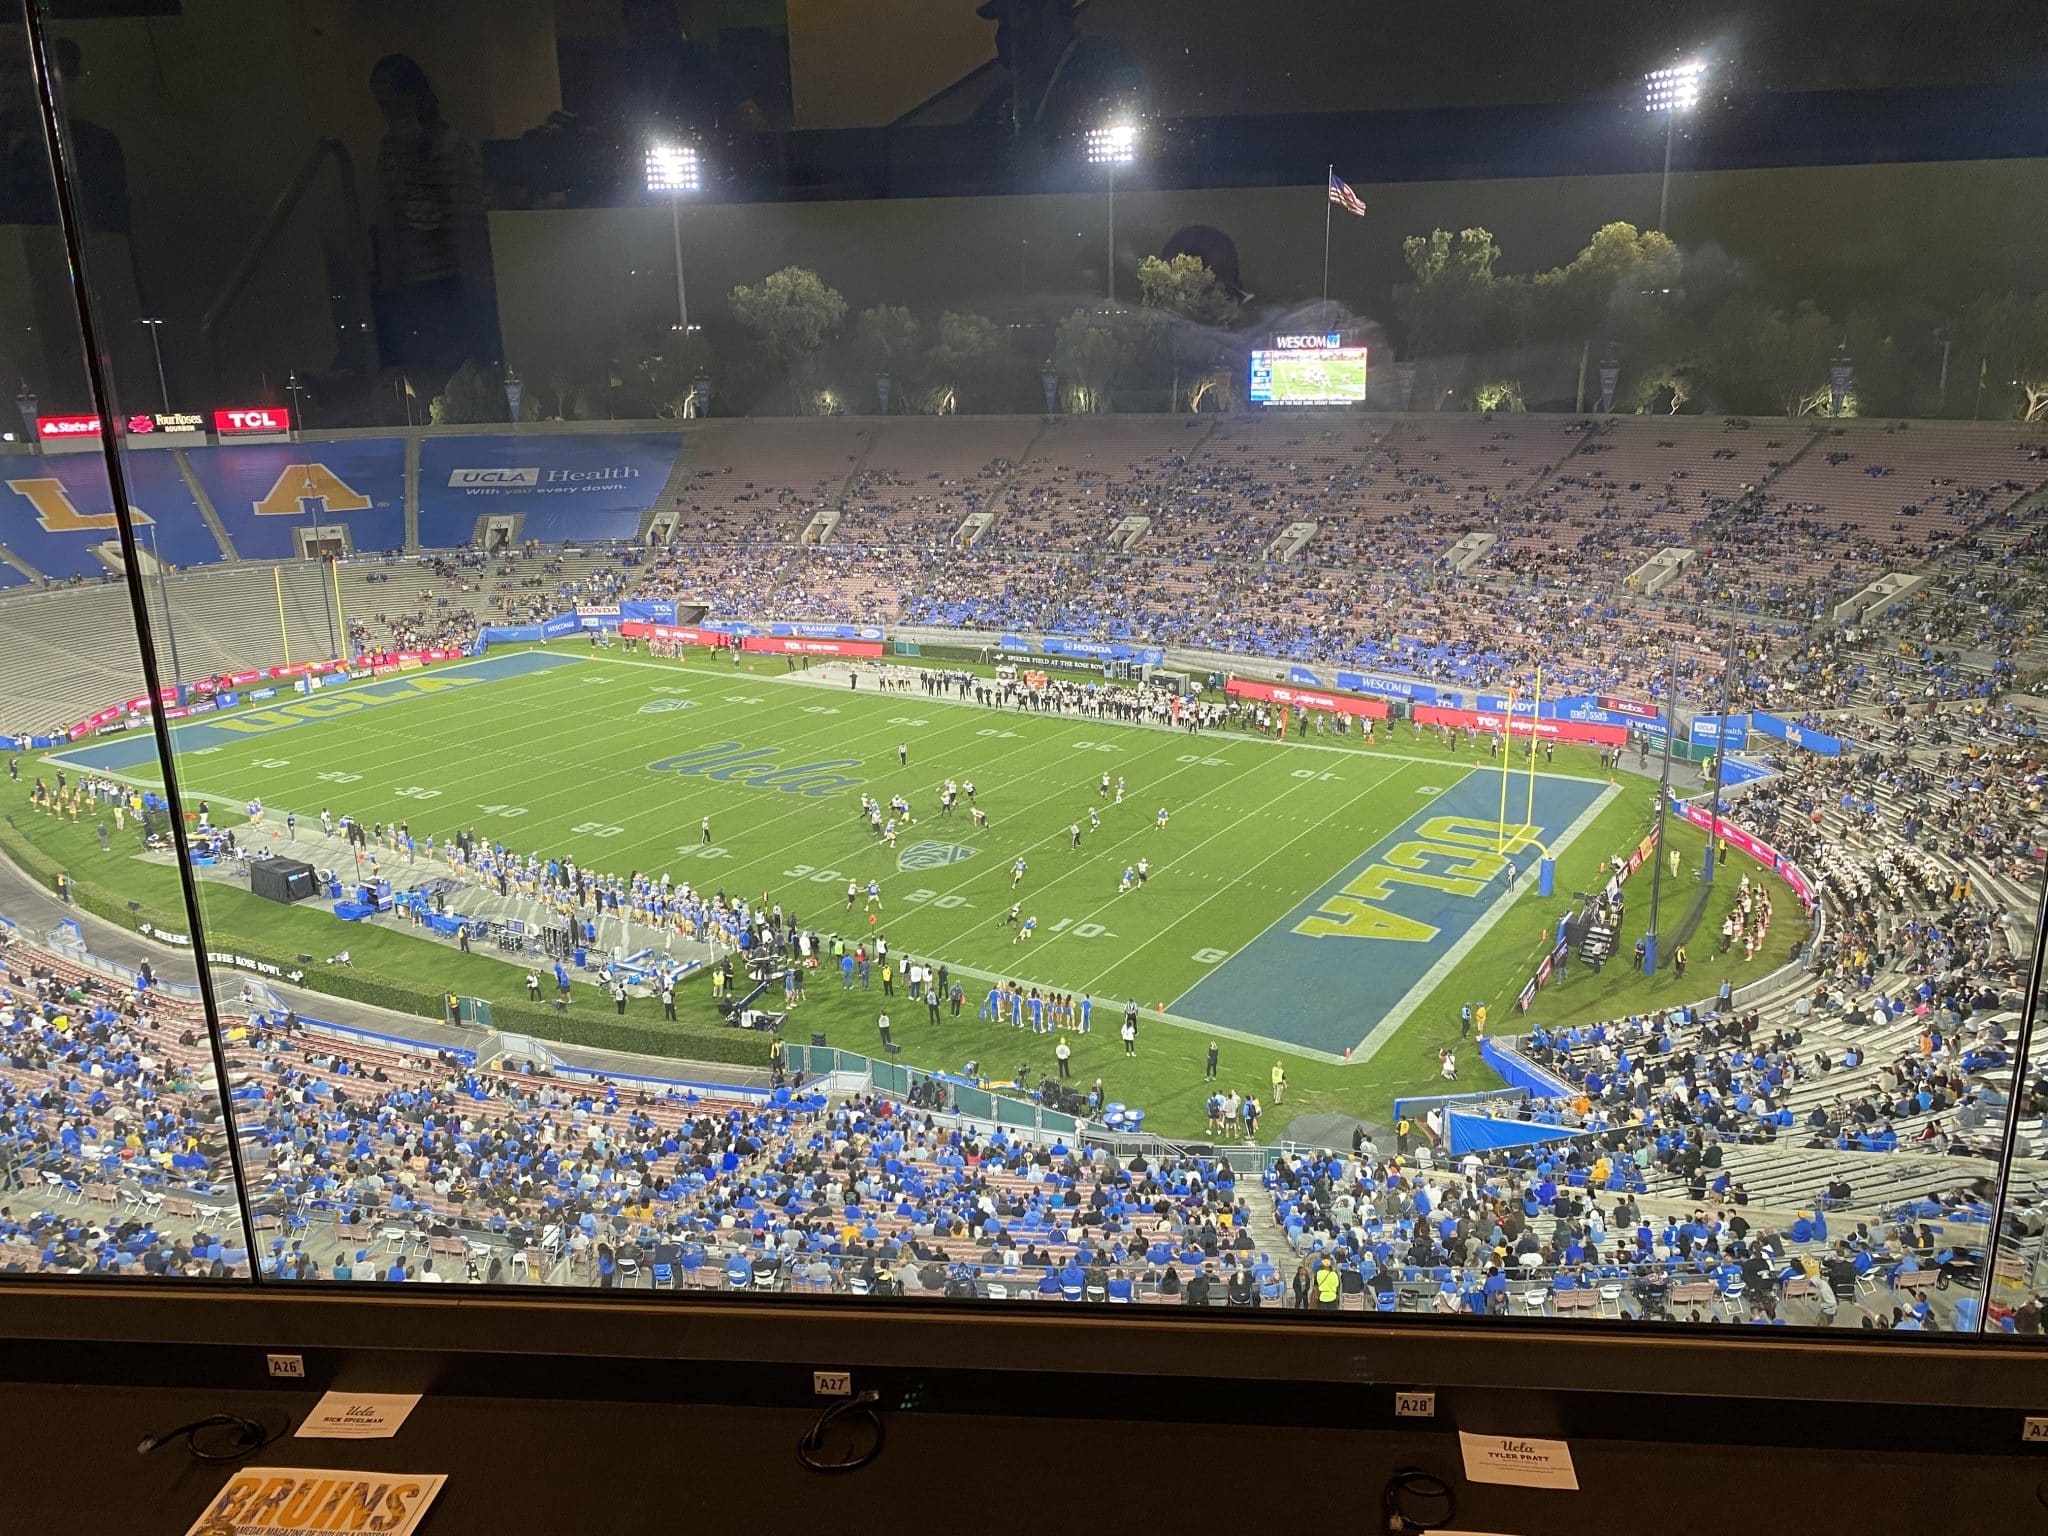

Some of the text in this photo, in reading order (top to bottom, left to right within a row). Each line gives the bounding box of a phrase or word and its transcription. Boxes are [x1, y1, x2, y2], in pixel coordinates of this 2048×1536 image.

[1277, 335, 1326, 349] WESCOM
[59, 421, 87, 433] State
[228, 412, 277, 428] TCL
[462, 466, 640, 483] UCLA Health
[252, 464, 374, 515] A
[466, 484, 627, 496] With you every down.
[578, 606, 620, 615] HONDA
[1073, 643, 1113, 654] HONDA
[1362, 677, 1402, 693] WESCOM
[1273, 689, 1292, 701] TCL
[209, 677, 486, 732] UCLA
[646, 742, 868, 797] Ucla
[397, 786, 443, 799] 30
[480, 804, 529, 817] 40
[571, 822, 624, 838] 50
[783, 864, 841, 883] 30
[1290, 816, 1545, 943] UCLA
[902, 889, 967, 908] 20
[1048, 918, 1106, 938] 10
[1191, 948, 1229, 964] G
[235, 956, 257, 969] ROSE
[257, 962, 283, 976] BOWL
[273, 1360, 297, 1373] A26
[820, 1378, 845, 1390] A27
[346, 1405, 376, 1417] Ucla
[1401, 1399, 1427, 1412] A28
[1501, 1440, 1536, 1453] Ucla
[1488, 1452, 1518, 1460] TYLER
[203, 1477, 421, 1533] BRUINS
[268, 1528, 305, 1536] MAGAZINE
